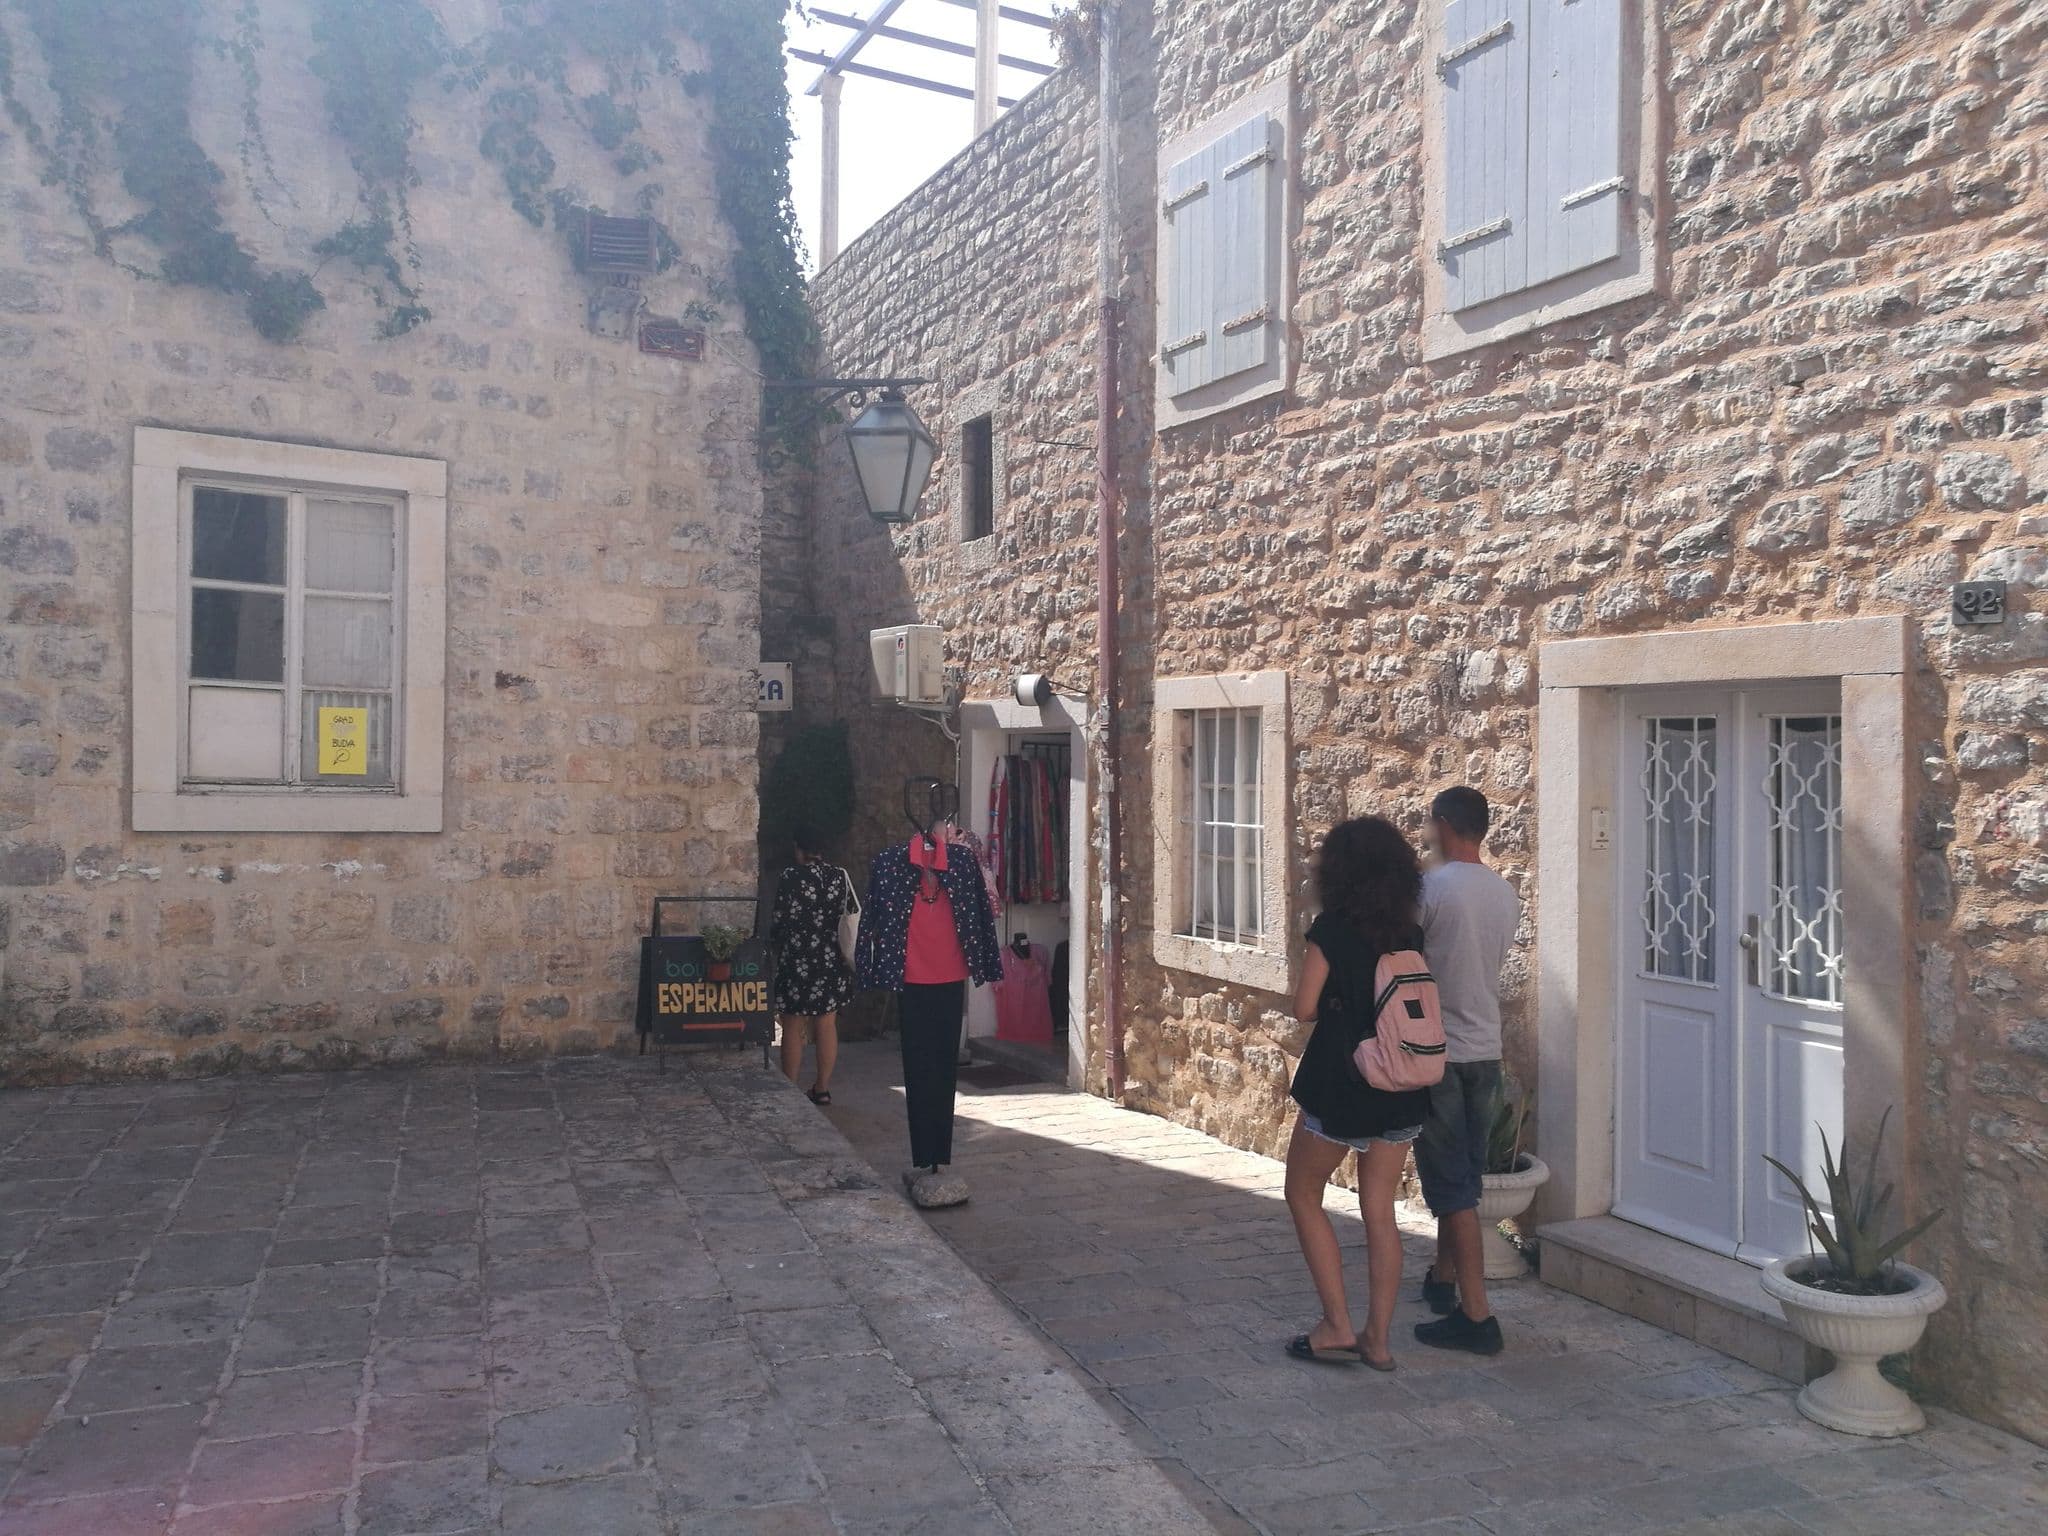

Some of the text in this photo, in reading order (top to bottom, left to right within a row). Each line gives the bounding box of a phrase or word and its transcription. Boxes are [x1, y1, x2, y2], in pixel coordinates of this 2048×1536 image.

[1961, 589, 1999, 613] 22
[331, 738, 355, 748] BUDVA
[666, 960, 760, 977] bouue
[658, 978, 768, 1014] ESPÉRANCE
